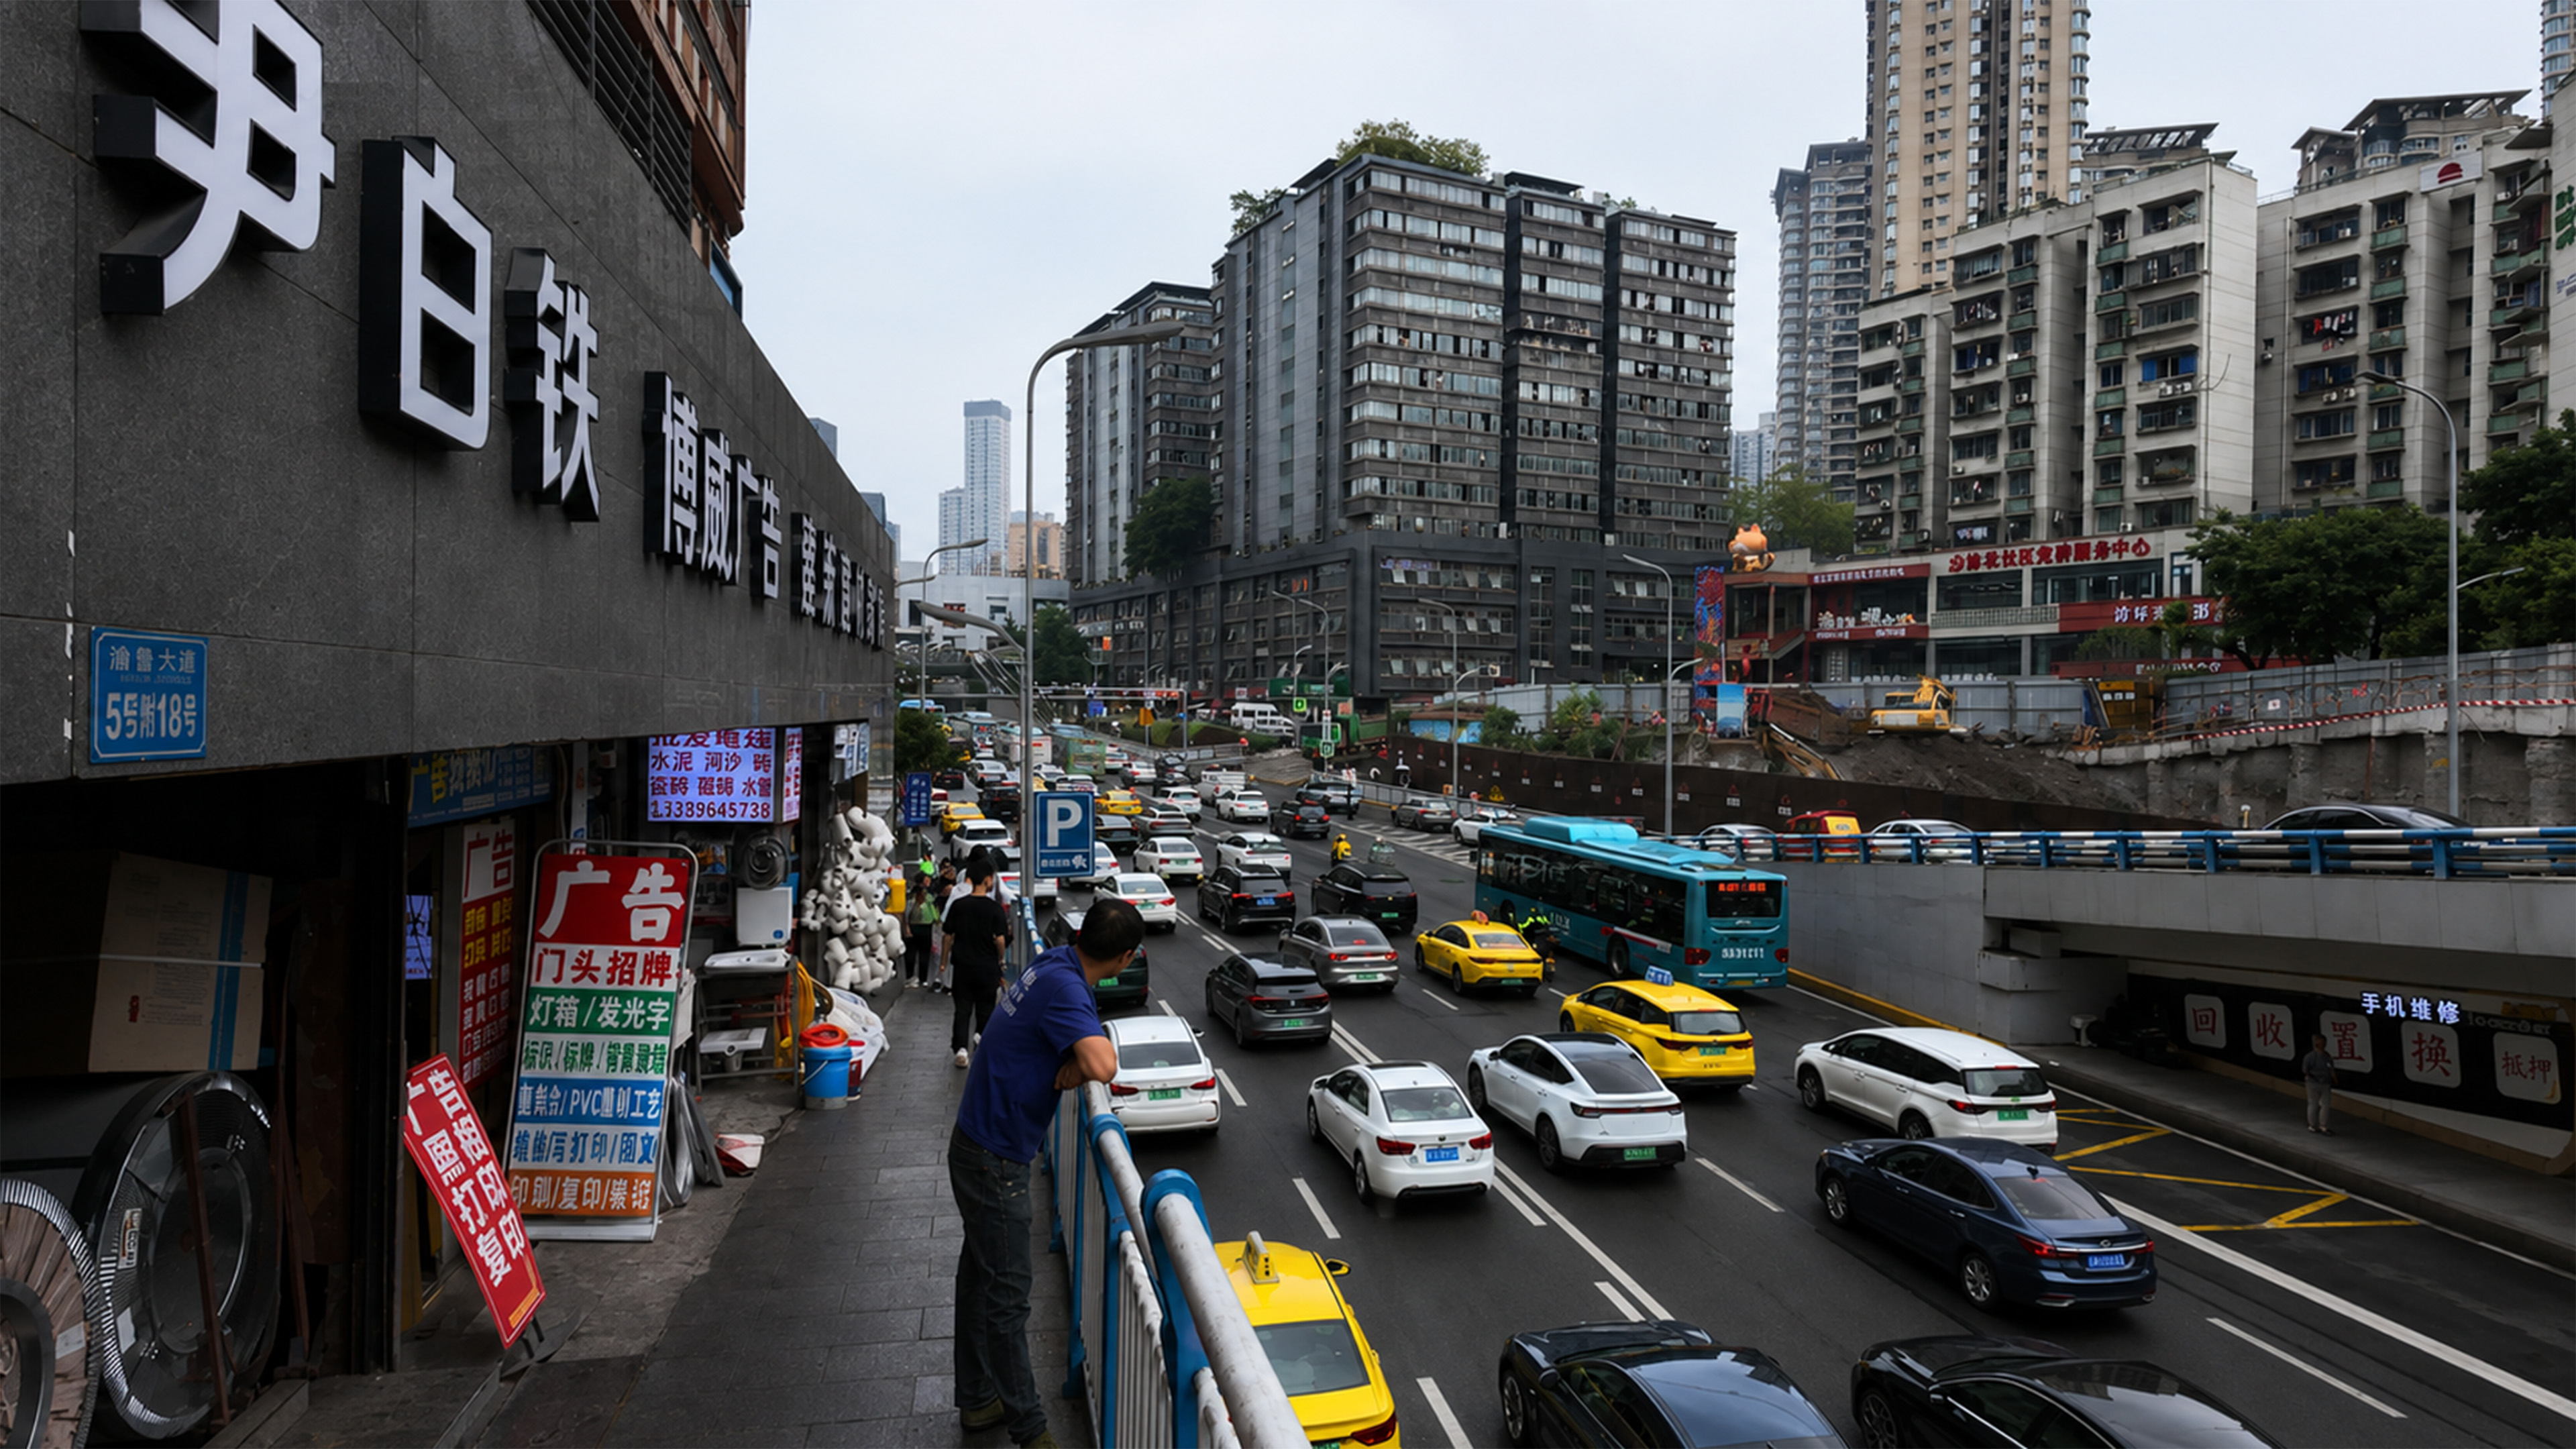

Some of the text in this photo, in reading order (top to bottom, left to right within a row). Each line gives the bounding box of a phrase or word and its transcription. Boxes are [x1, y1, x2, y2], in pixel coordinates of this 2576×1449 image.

[662, 374, 782, 600] 博威广告
[651, 751, 693, 771] 水泥
[1046, 799, 1083, 847] P
[538, 860, 686, 943] 广告
[535, 947, 672, 987] 门头招牌
[529, 994, 670, 1030] 灯箱/发光字
[2360, 991, 2461, 1025] 手机维修
